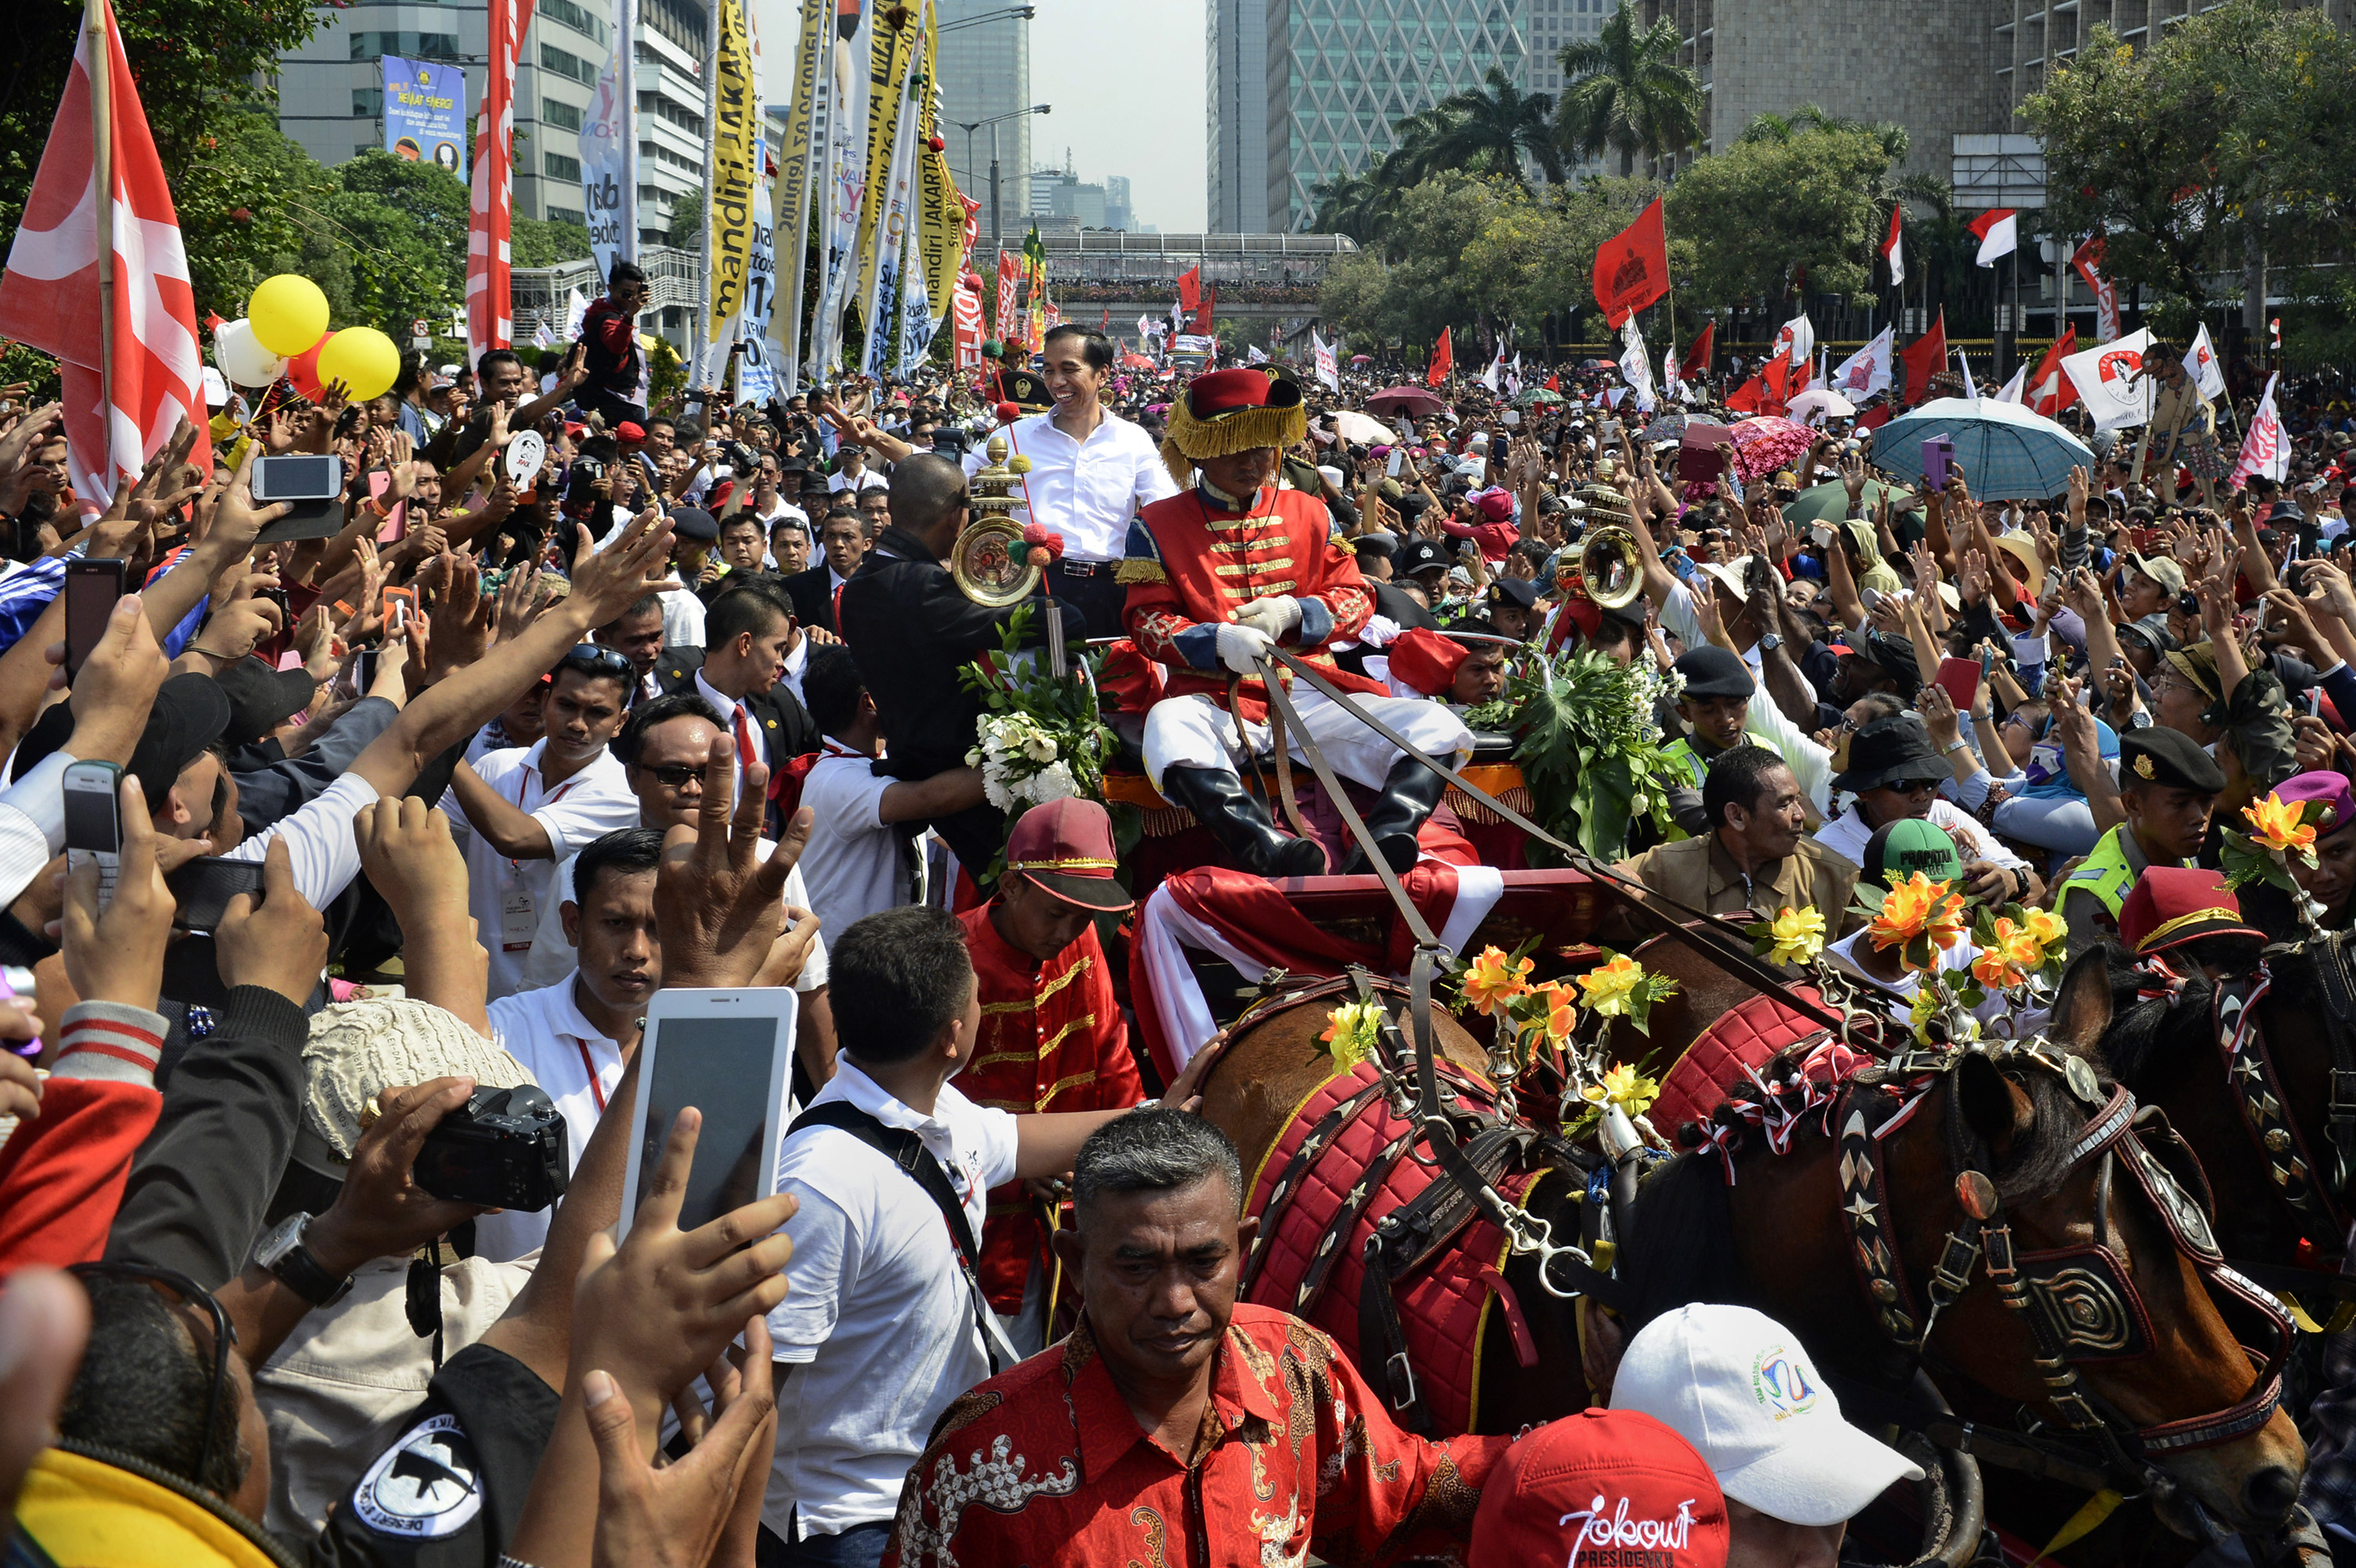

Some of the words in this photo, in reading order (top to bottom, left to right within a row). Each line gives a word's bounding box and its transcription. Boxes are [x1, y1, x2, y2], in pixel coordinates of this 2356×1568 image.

[900, 10, 918, 55] 2014
[923, 152, 942, 229] JAKARTA
[715, 159, 748, 318] mandiri
[925, 235, 942, 309] mandiri
[1901, 849, 1953, 866] PRAPATAN
[371, 1512, 424, 1532] DESERT
[1578, 1549, 1674, 1568] PRESIDENKU
